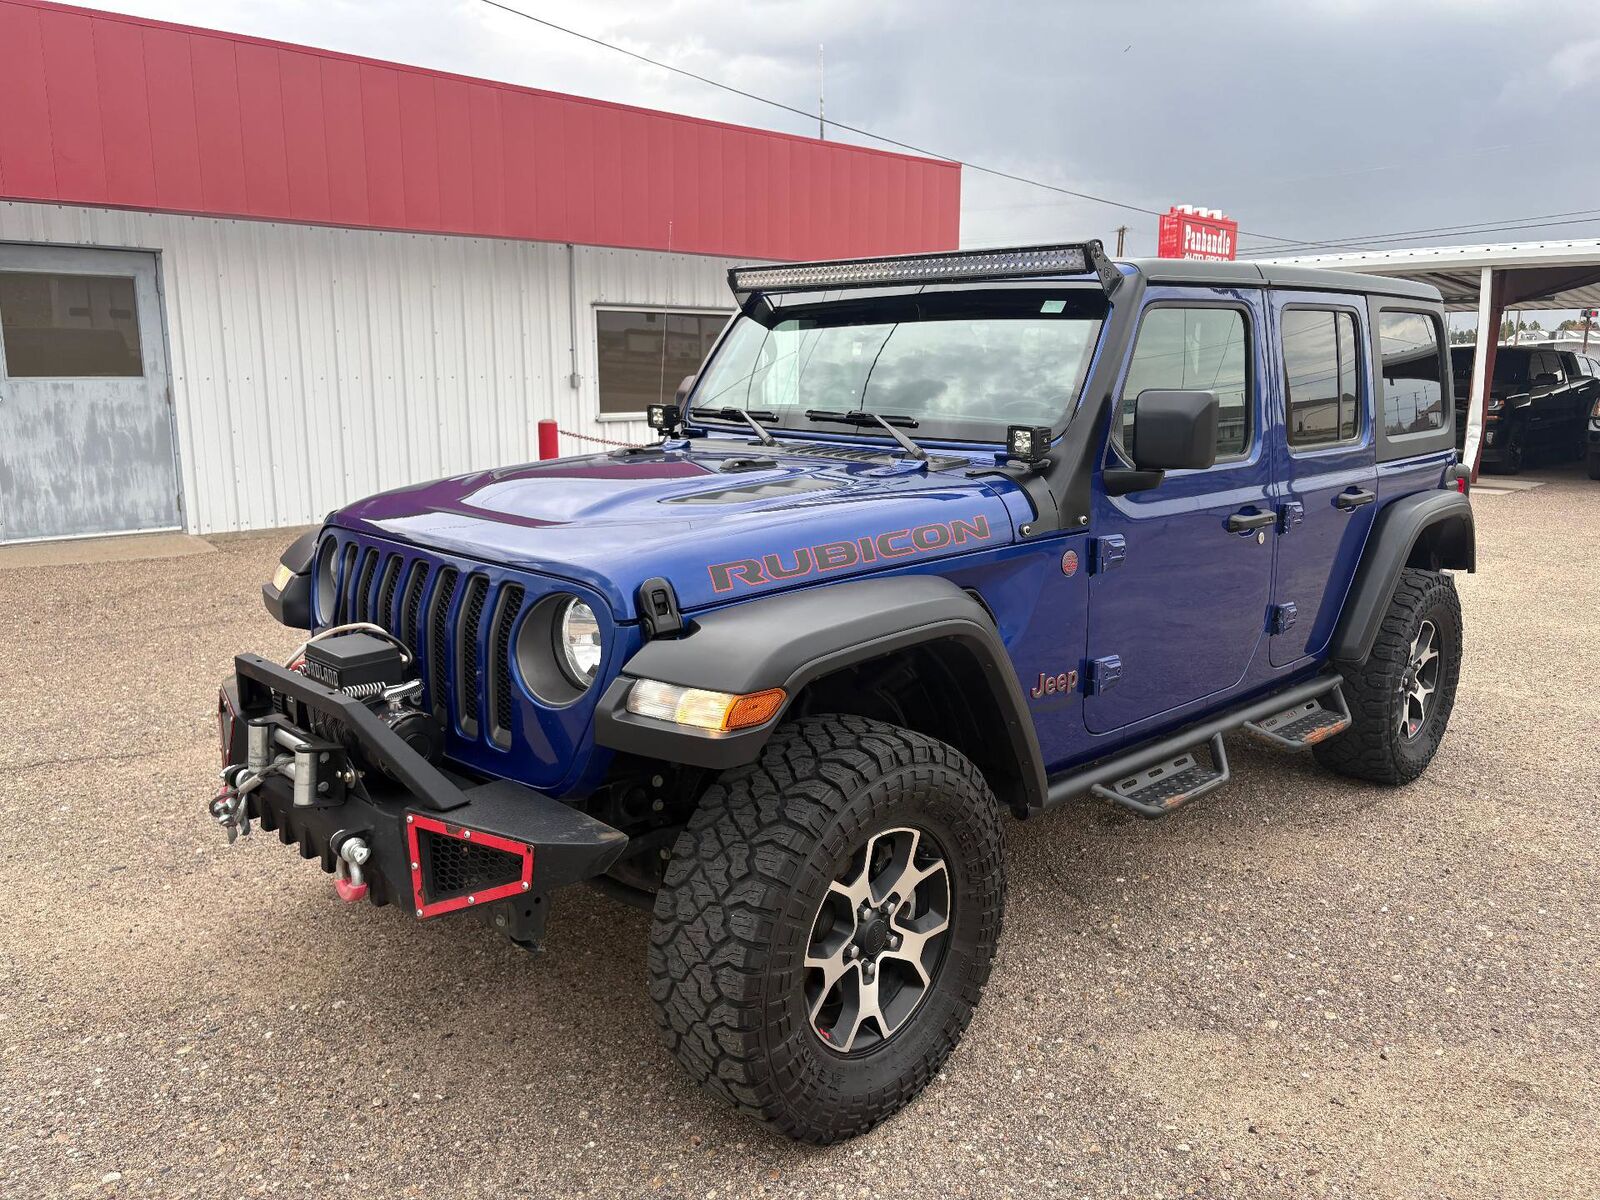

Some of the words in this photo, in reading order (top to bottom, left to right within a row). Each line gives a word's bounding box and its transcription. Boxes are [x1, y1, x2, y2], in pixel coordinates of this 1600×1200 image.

[1185, 224, 1231, 255] Panhandle
[707, 515, 990, 593] RUBICON
[1030, 670, 1078, 699] Jeep
